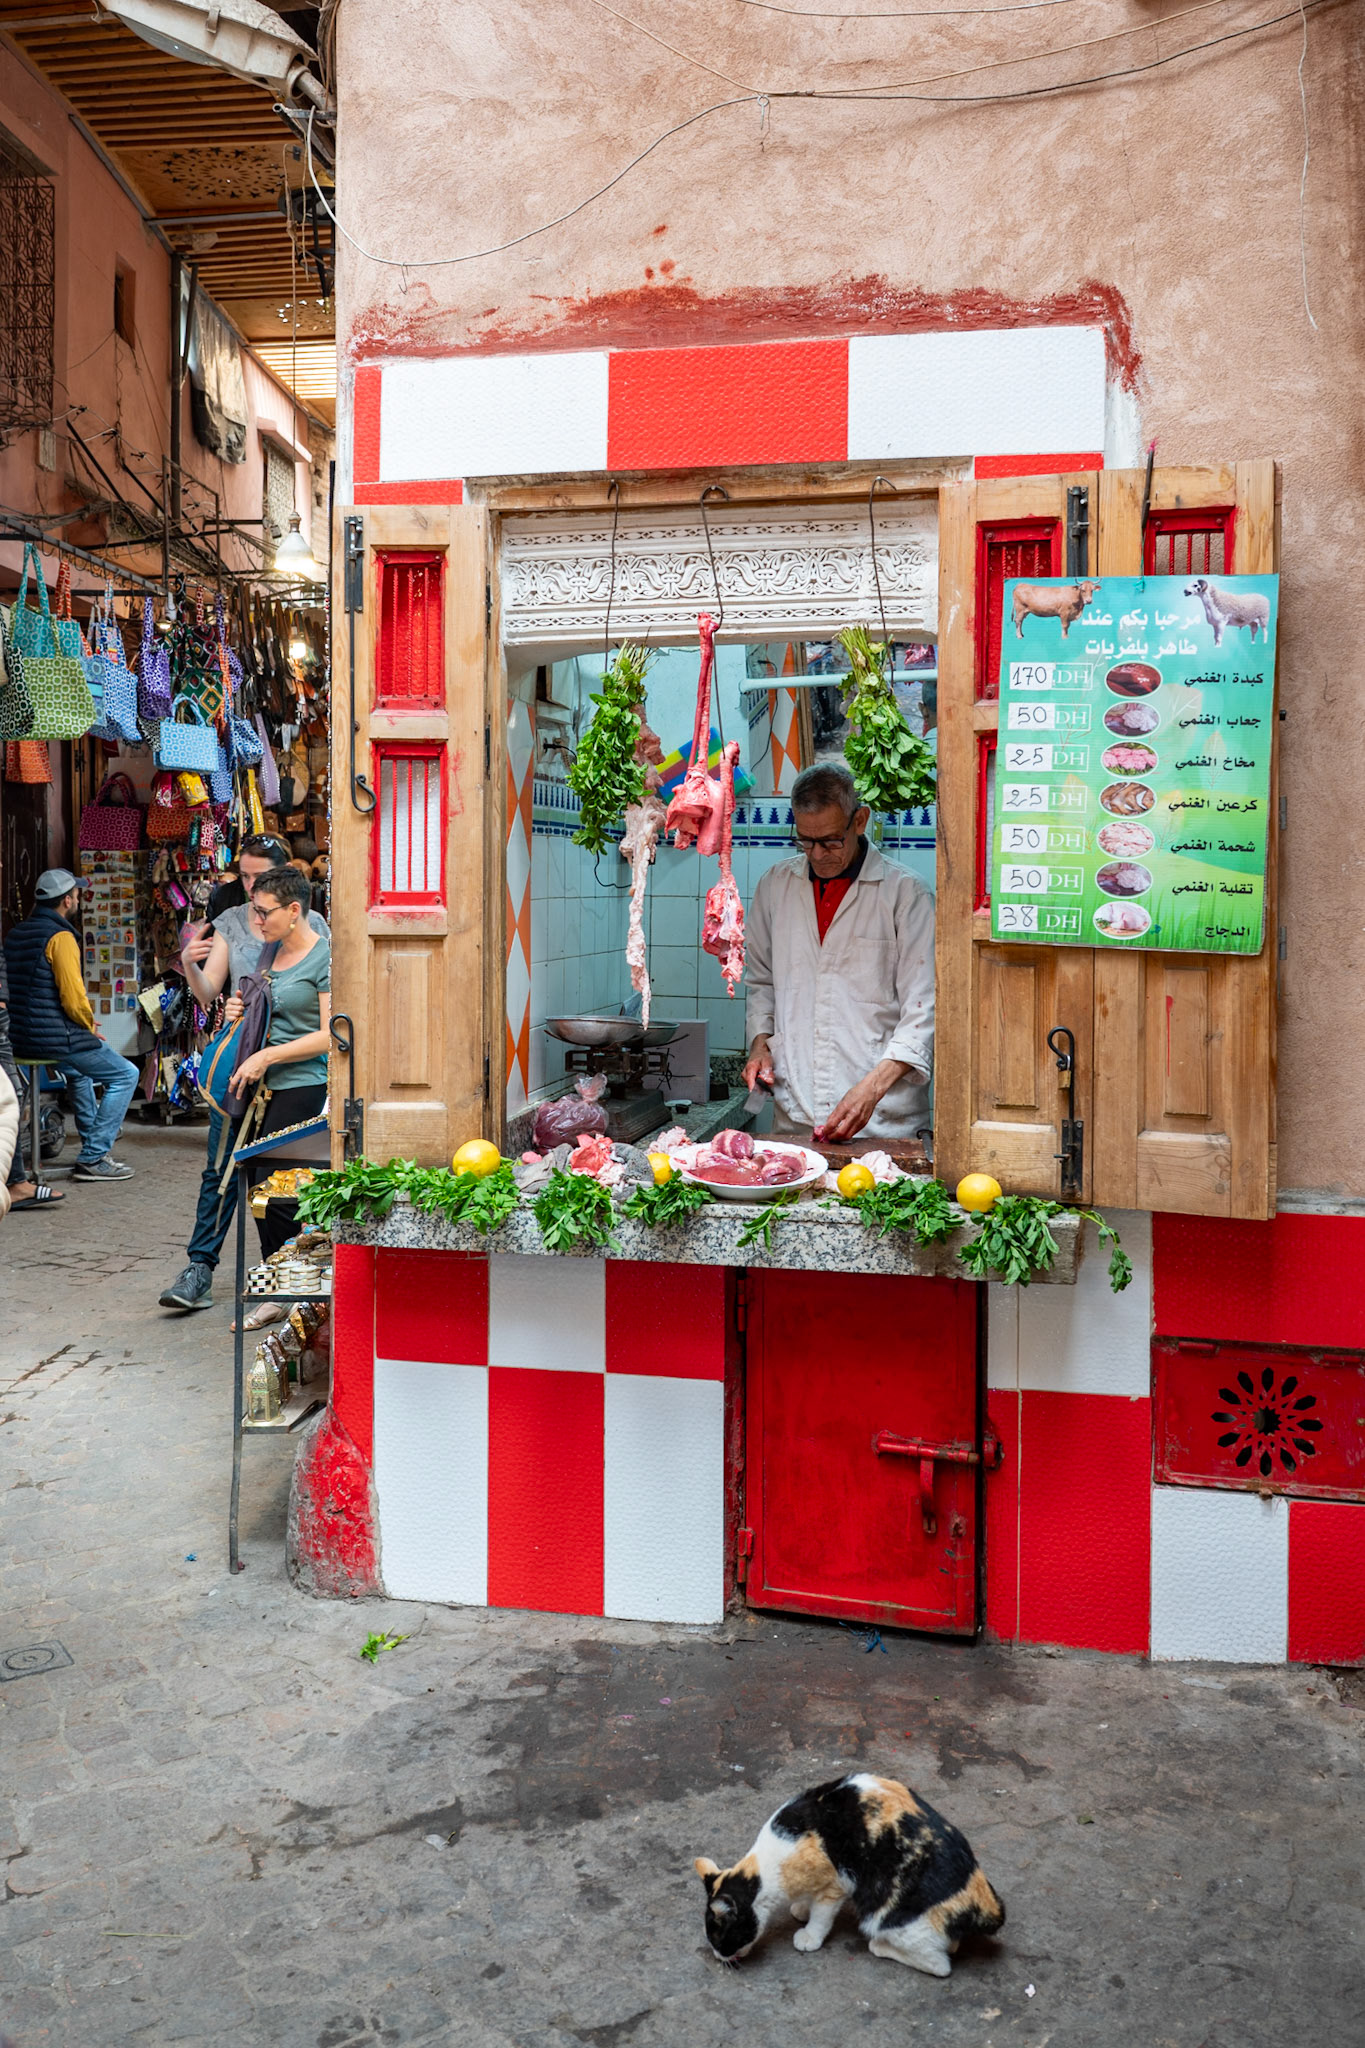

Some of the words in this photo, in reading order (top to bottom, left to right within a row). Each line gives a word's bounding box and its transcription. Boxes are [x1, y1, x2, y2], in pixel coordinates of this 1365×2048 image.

[1081, 609, 1113, 626] عند
[1119, 608, 1149, 630] بكم
[1155, 610, 1201, 630] مرحبا
[1085, 637, 1149, 660] بلفريات
[1152, 638, 1198, 659] طاهر
[1012, 665, 1047, 686] 170
[1184, 672, 1226, 687] الغنمي
[1232, 672, 1264, 687] كبدة
[1017, 706, 1047, 725] 50
[1055, 710, 1087, 725] DH
[1178, 714, 1220, 729] الغنمي
[1226, 715, 1261, 729] جعاب
[1009, 747, 1044, 767] 25
[1053, 750, 1085, 766] DH
[1175, 755, 1217, 771] الغنمي
[1222, 757, 1256, 771] مخاخ
[1005, 786, 1043, 807] 25
[1051, 791, 1083, 806] DH
[1168, 797, 1210, 812] الغنمي
[1216, 799, 1258, 813] كرعين
[1009, 828, 1041, 849] 50
[1049, 831, 1081, 847] DH
[1170, 839, 1212, 854] الغنمي
[1218, 840, 1256, 853] شحمة
[1010, 869, 1042, 889] 50
[1048, 872, 1080, 888] DH
[1172, 881, 1214, 896] الغنمي
[1219, 882, 1253, 897] تقلية
[1002, 906, 1034, 928] 38
[1045, 913, 1078, 929] DH
[1204, 925, 1250, 938] الدجاج
